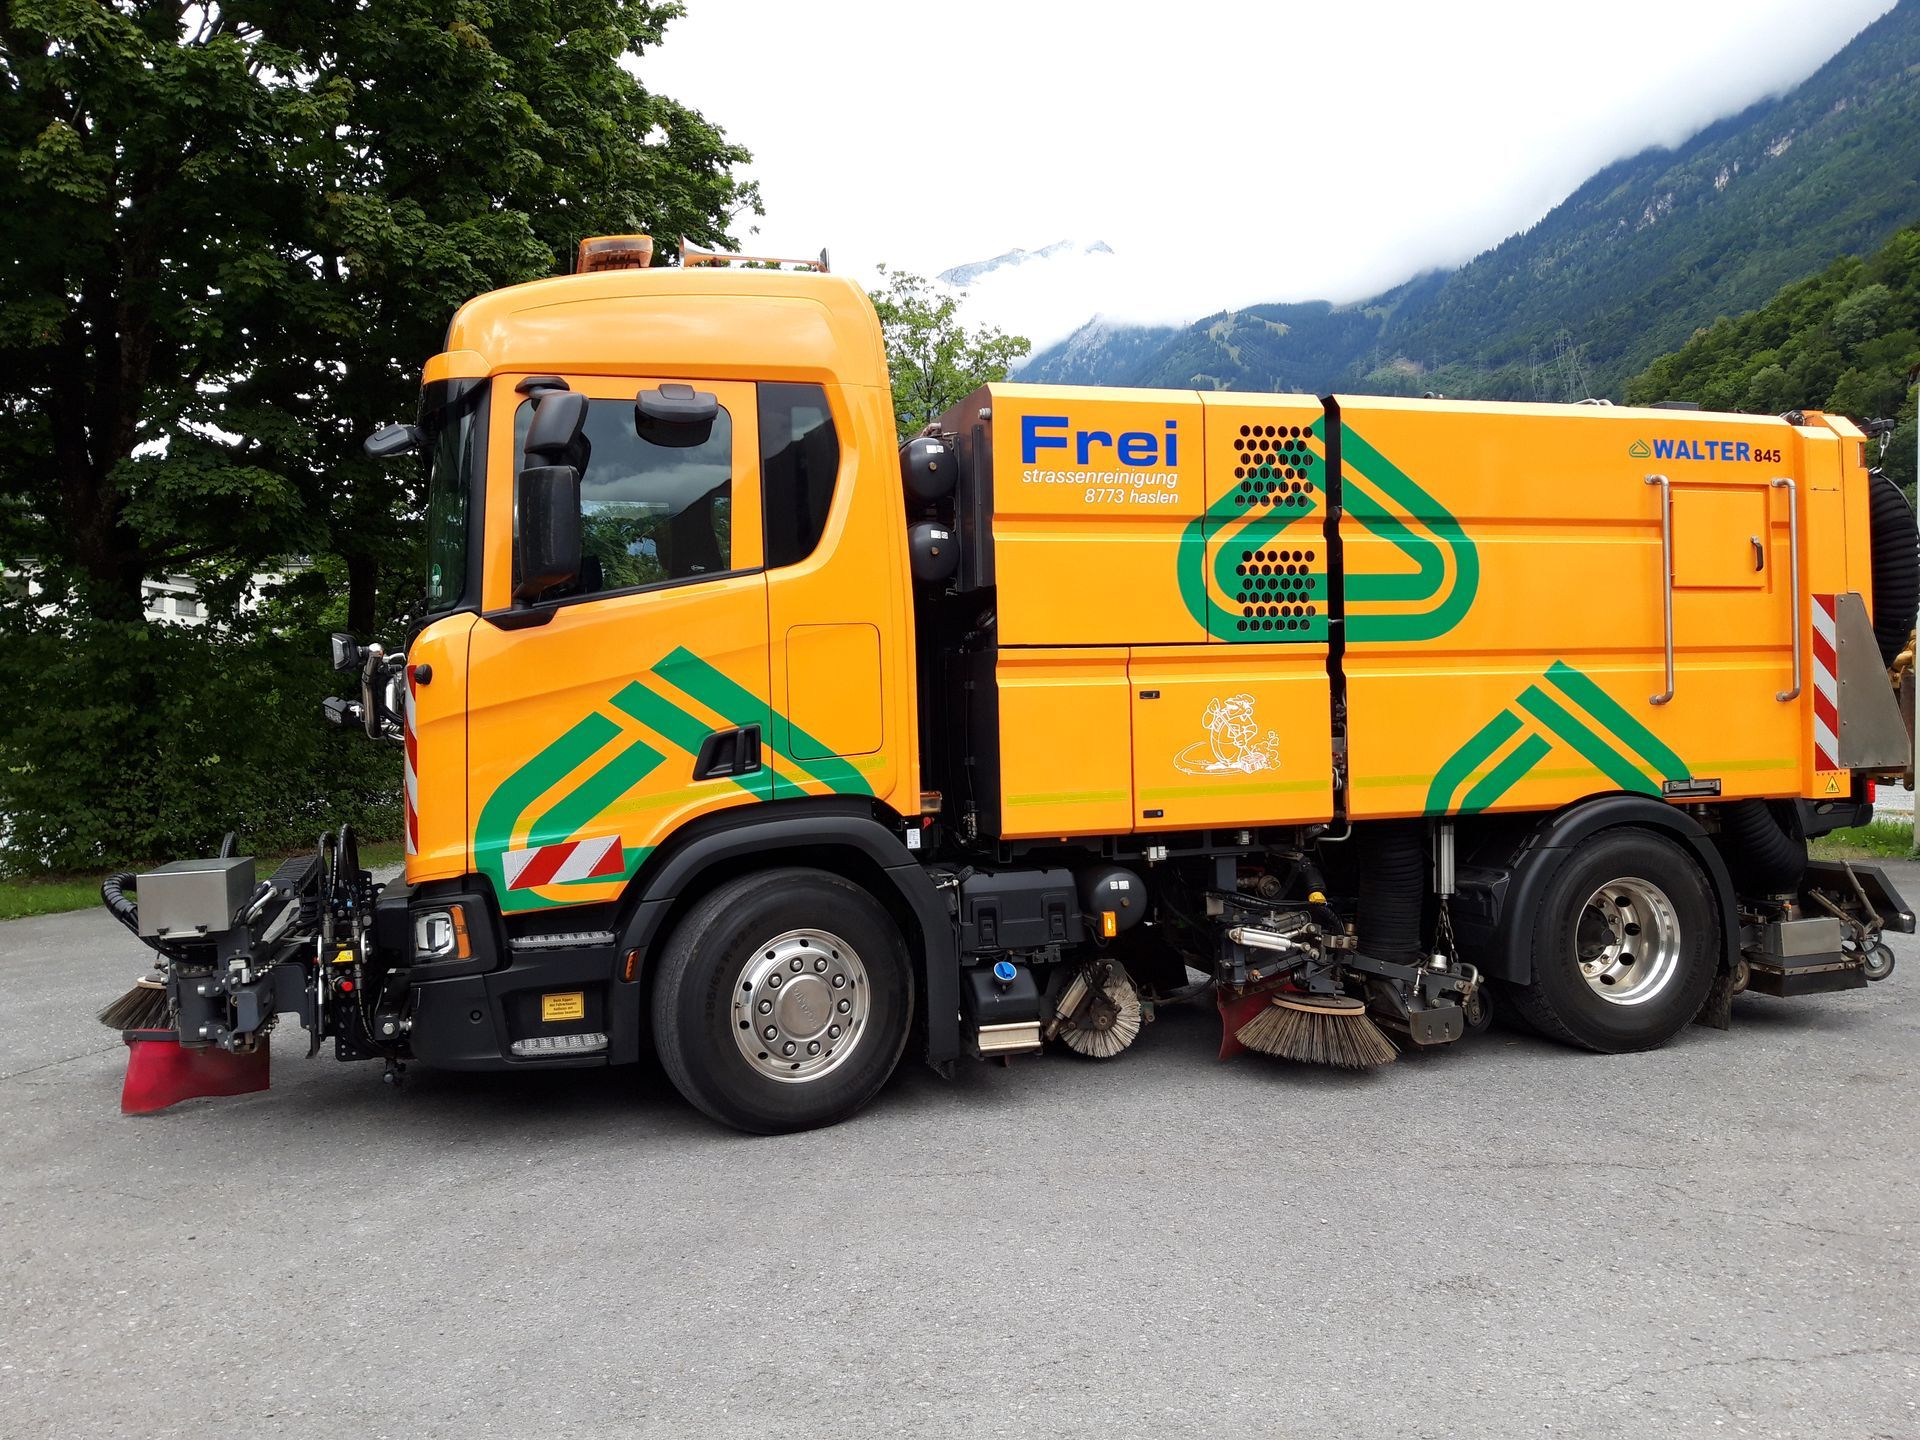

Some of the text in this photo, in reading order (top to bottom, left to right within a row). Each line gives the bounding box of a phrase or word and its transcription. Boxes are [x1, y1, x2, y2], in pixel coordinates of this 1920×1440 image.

[1021, 415, 1177, 467] Frei
[1653, 439, 1781, 463] WALTER 845
[1022, 468, 1178, 488] strassenreinigung
[1084, 488, 1179, 504] 8773 haslen
